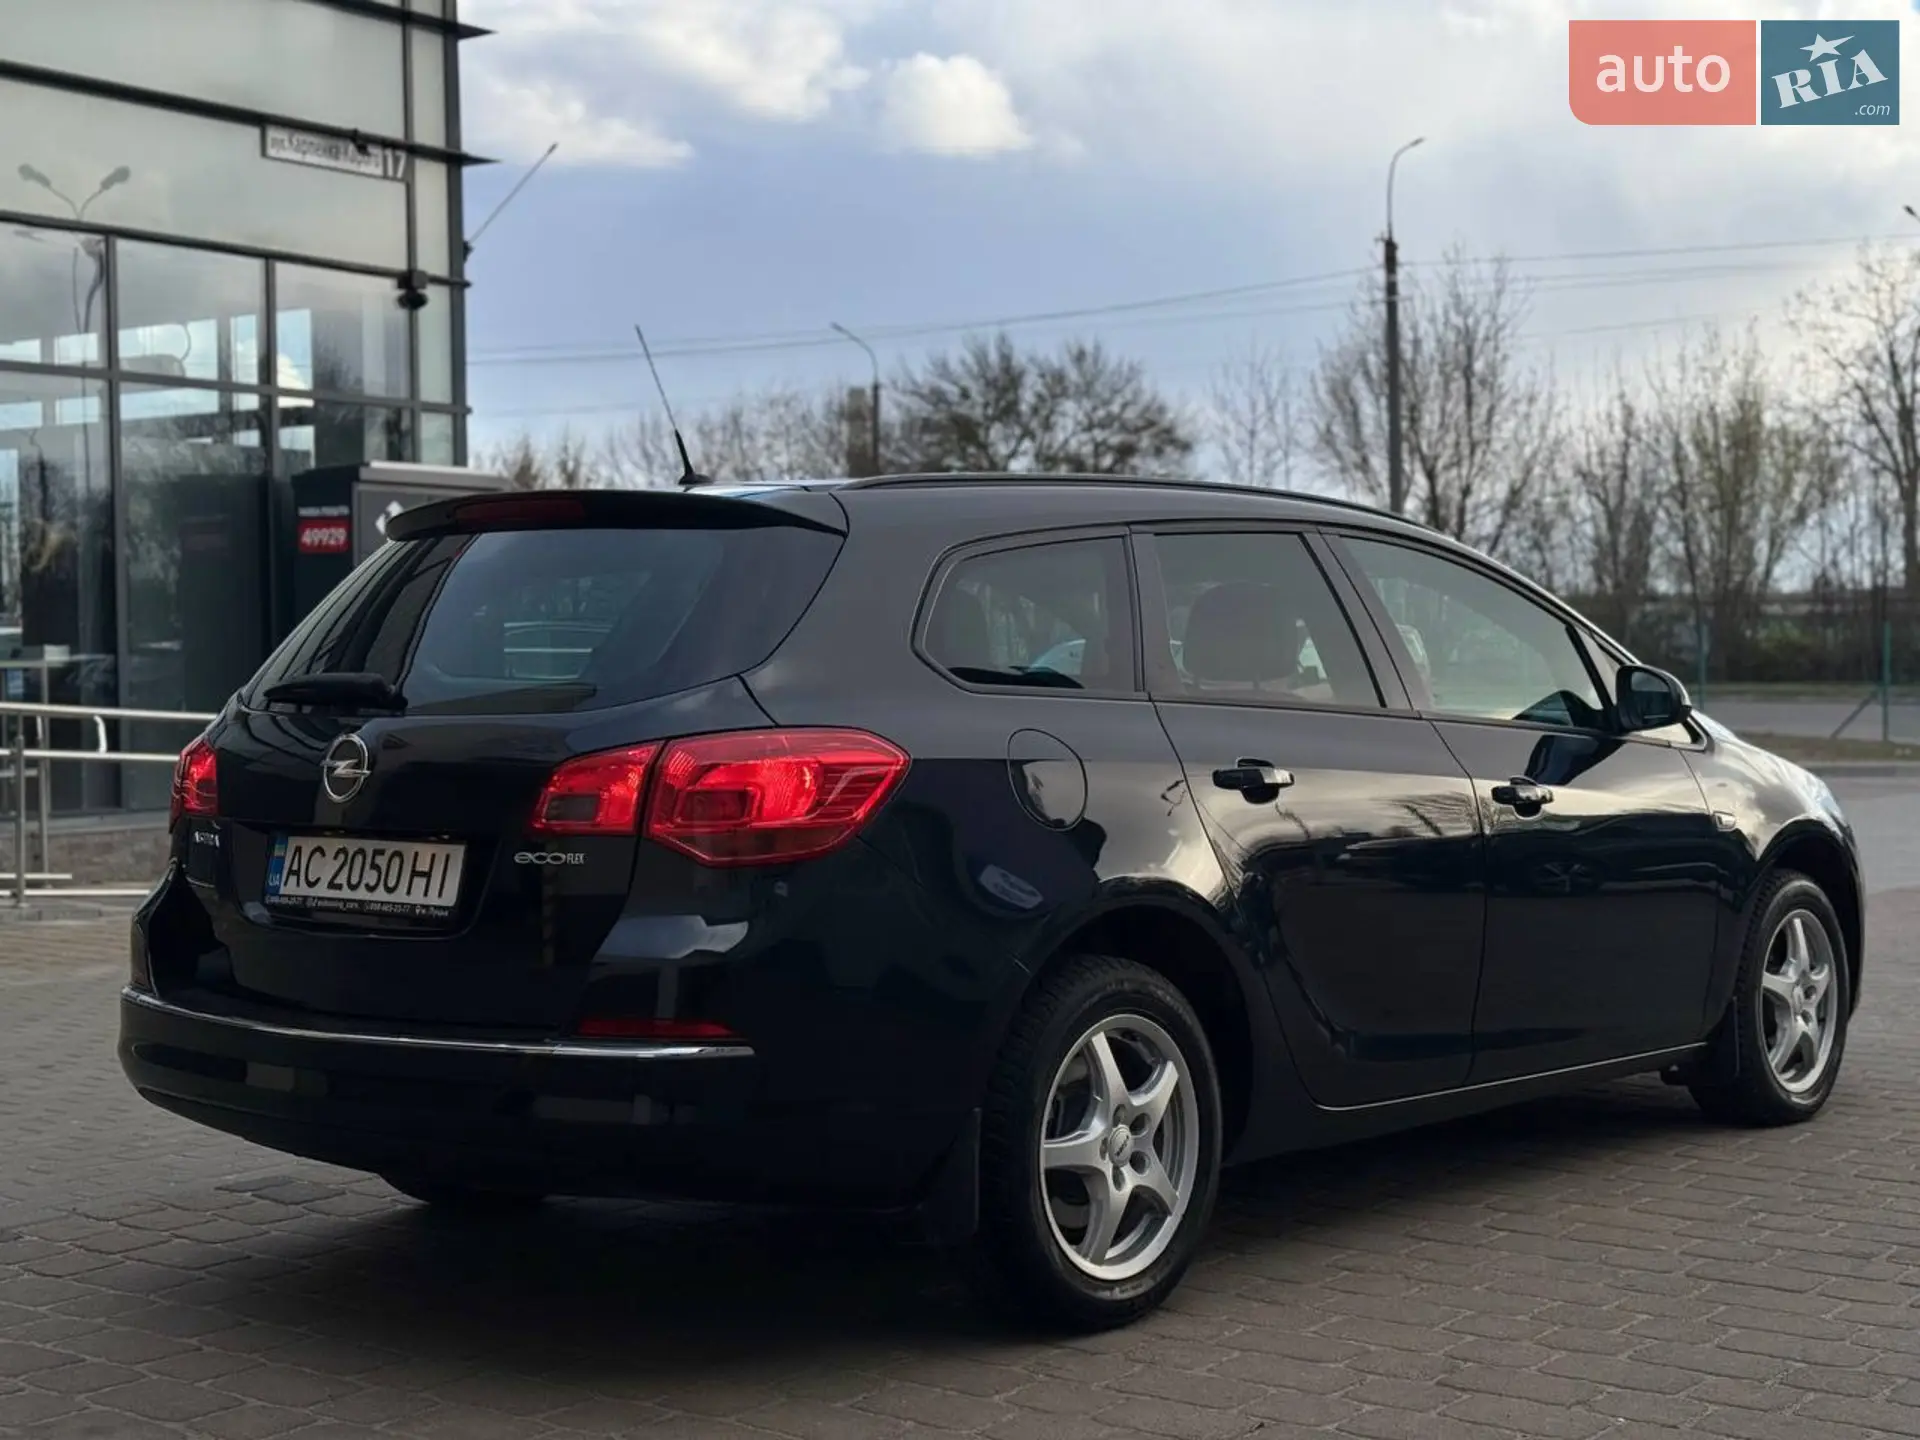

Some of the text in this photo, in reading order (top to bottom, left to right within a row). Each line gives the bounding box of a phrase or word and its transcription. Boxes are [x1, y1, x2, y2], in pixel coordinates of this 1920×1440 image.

[384, 149, 406, 178] 17
[301, 527, 347, 546] 49929
[283, 845, 450, 898] AC 2050 HI
